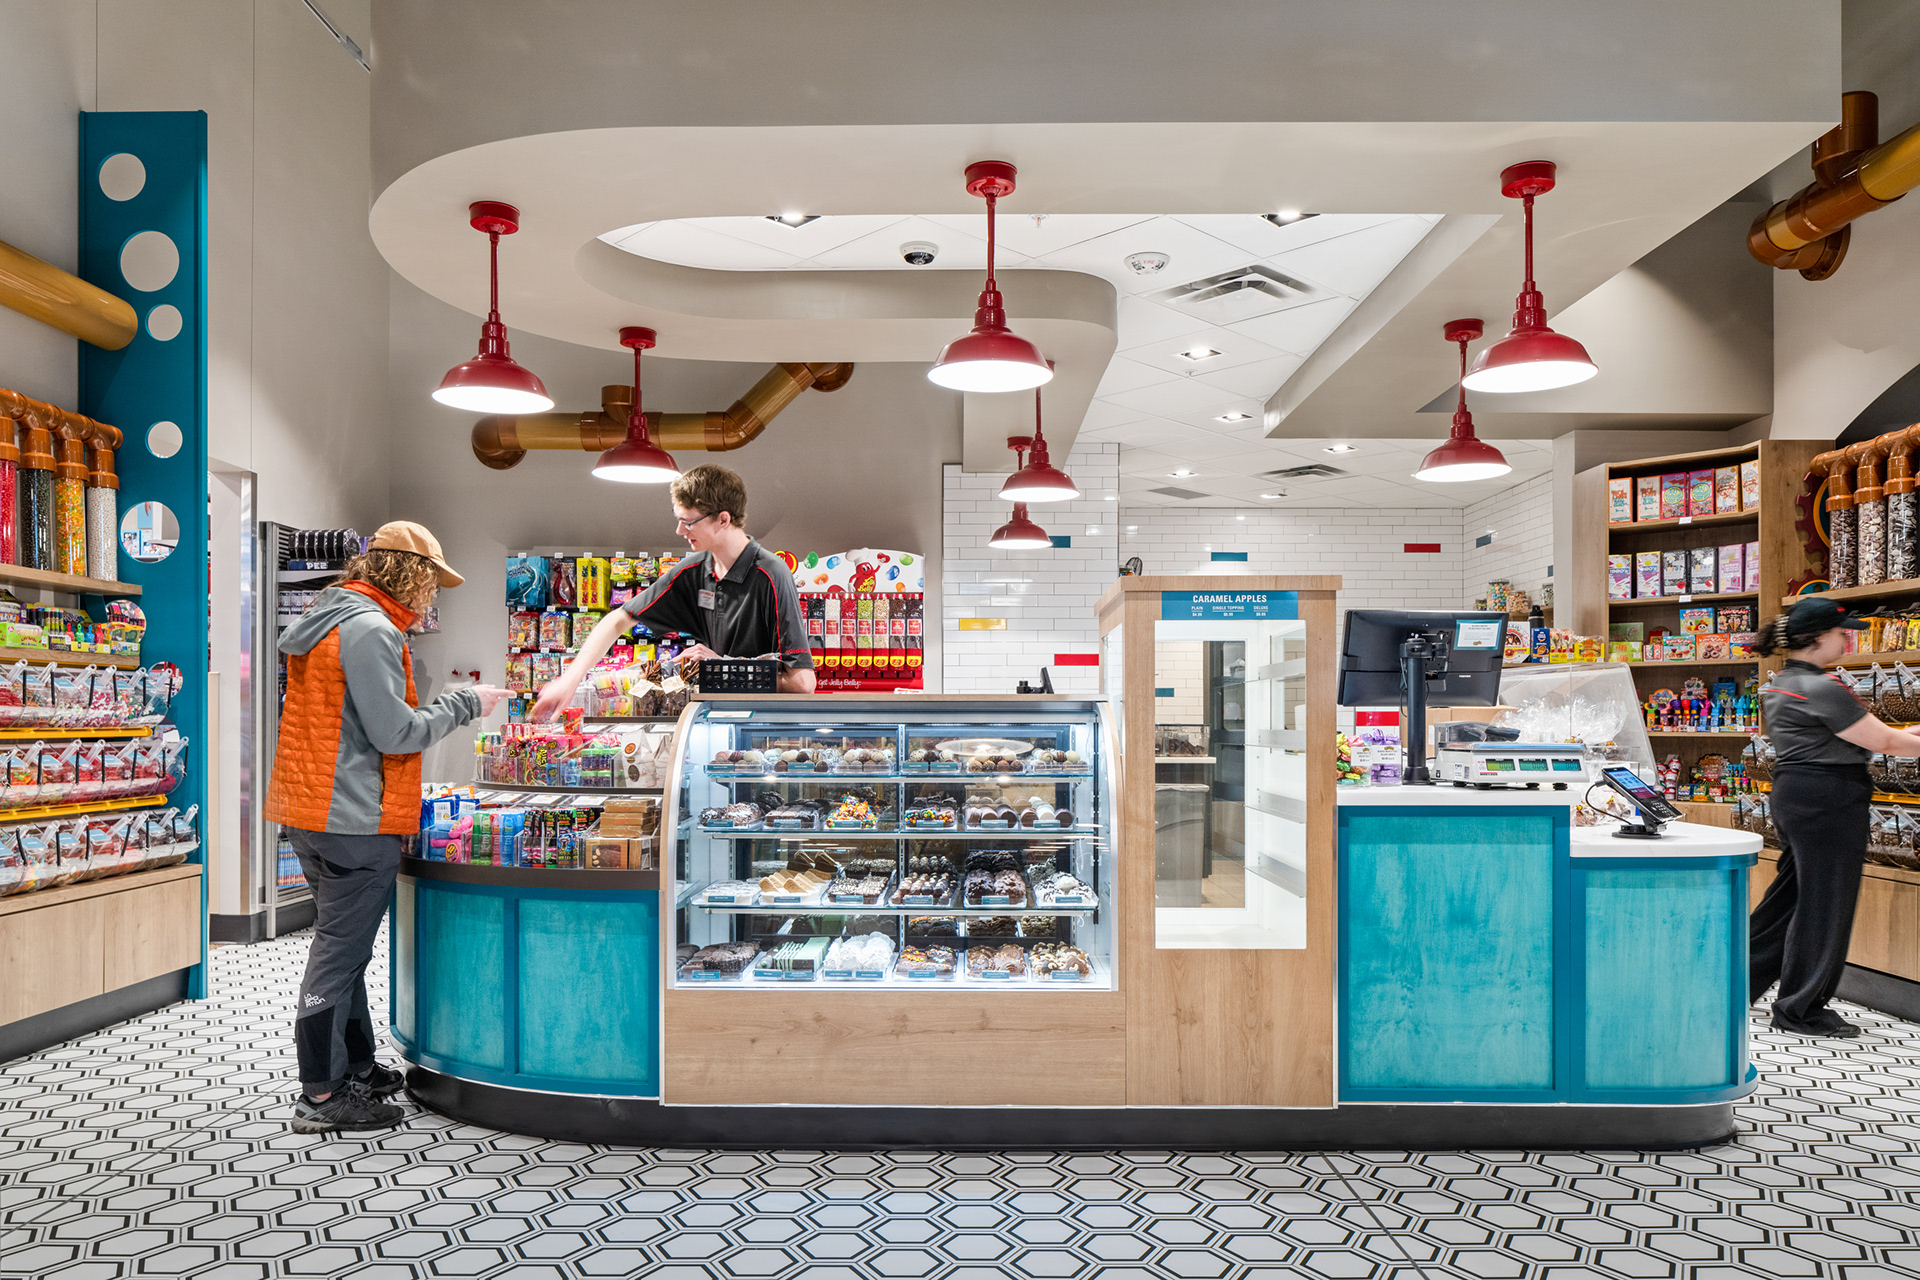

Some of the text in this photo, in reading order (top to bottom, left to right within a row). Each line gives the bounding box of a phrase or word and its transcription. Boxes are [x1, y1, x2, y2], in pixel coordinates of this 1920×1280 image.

[306, 562, 328, 570] PEZ
[1192, 594, 1267, 603] CARAMEL APPLES
[818, 679, 828, 688] Get
[829, 679, 843, 689] Jelly
